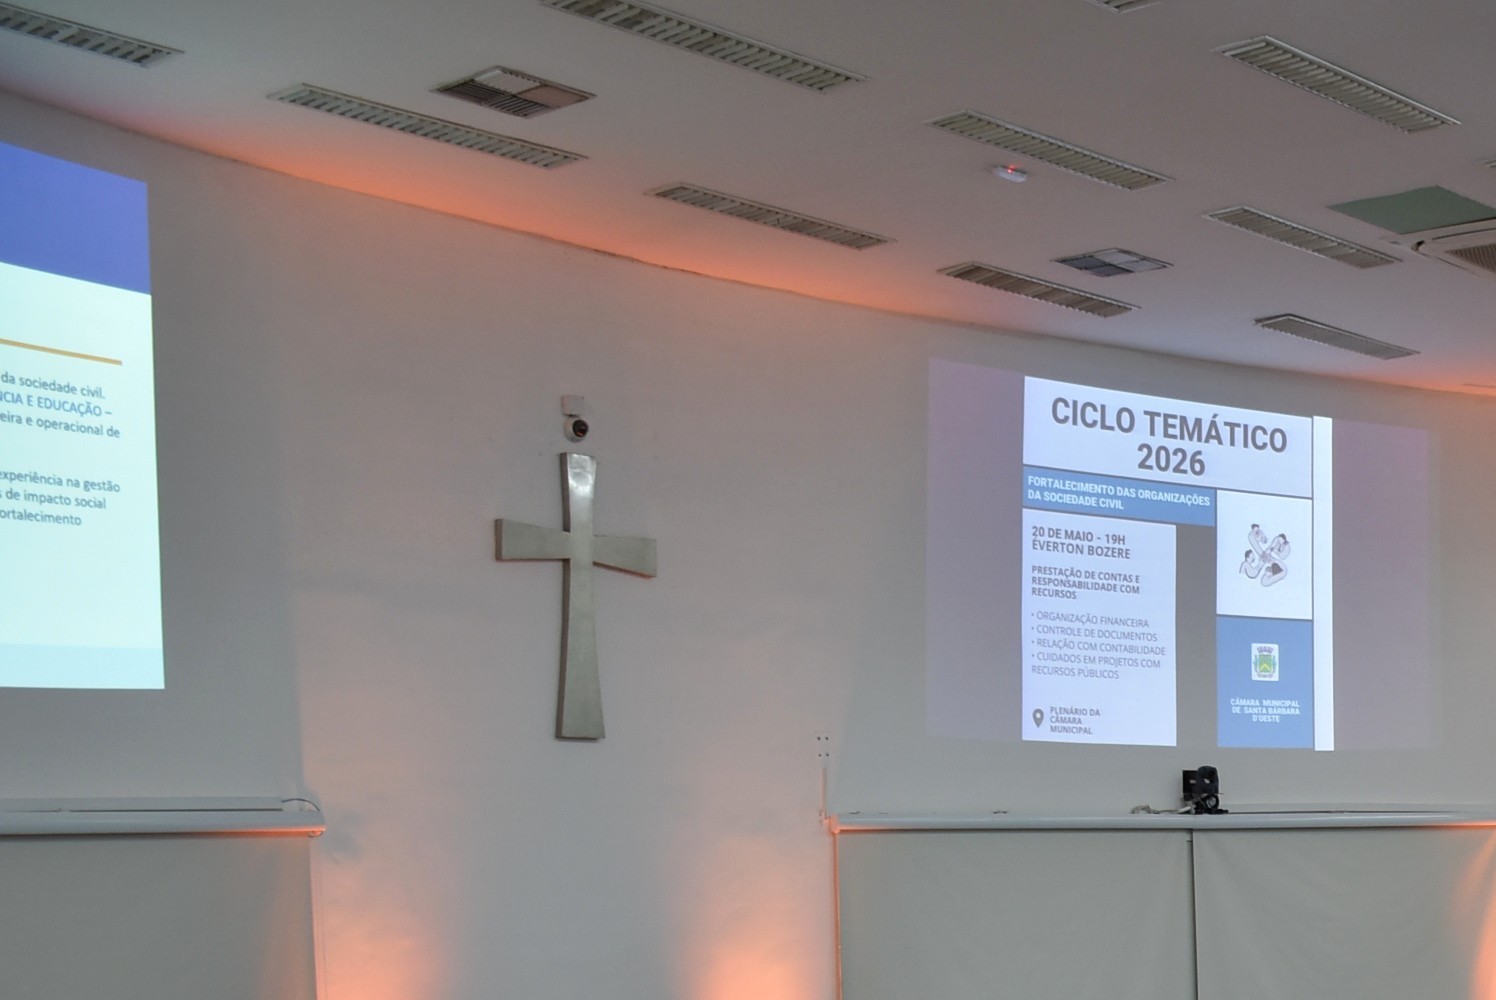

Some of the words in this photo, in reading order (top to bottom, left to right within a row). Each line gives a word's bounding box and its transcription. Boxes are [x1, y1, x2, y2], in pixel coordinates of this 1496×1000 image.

[1, 371, 16, 385] da
[19, 377, 78, 395] sociedade
[80, 385, 106, 399] civil.
[27, 394, 34, 406] E
[37, 396, 102, 417] EDUCAÇÃO
[26, 416, 33, 426] e
[36, 418, 104, 436] operacional
[106, 425, 120, 438] de
[1052, 397, 1135, 434] CICLO
[1143, 411, 1288, 453] TEMÁTICO
[1137, 443, 1206, 476] 2026
[66, 478, 80, 488] na
[83, 479, 120, 492] gestão
[1028, 475, 1115, 496] FORTALECIMENTO
[1117, 486, 1136, 498] DAS
[1138, 489, 1211, 507] ORGANIZAÇÕES
[5, 488, 20, 500] de
[24, 489, 71, 506] impacto
[75, 497, 106, 509] social
[1028, 489, 1041, 500] DA
[1043, 491, 1098, 507] SOCIEDADE
[1099, 498, 1124, 510] CIVIL
[1032, 525, 1045, 538] 20
[1048, 527, 1062, 539] DE
[1064, 529, 1093, 542] MAIO
[1105, 533, 1126, 545] 19H
[1032, 537, 1084, 555] ÉVERTON
[1087, 546, 1131, 559] BOZERE
[1031, 565, 1082, 579] PRESTAÇÃO
[1084, 570, 1096, 580] DE
[1098, 571, 1133, 583] CONTAS
[1135, 575, 1140, 583] E
[1031, 576, 1118, 592] RESPONSABILIDADE
[1120, 584, 1140, 594] COM
[1031, 587, 1077, 600] RECURSOS
[1036, 611, 1098, 625] ORGANIZAÇÃO
[1100, 616, 1149, 628] FINANCEIRA
[1036, 624, 1081, 637] CONTROLE
[1084, 628, 1096, 638] DE
[1097, 629, 1158, 642] DOCUMENTOS
[1037, 638, 1075, 650] RELAÇÃO
[1077, 641, 1097, 651] COM
[1100, 643, 1166, 655] CONTABILIDADE
[1037, 651, 1081, 664] CUIDADOS
[1083, 655, 1096, 664] EM
[1098, 656, 1139, 668] PROJETOS
[1141, 659, 1161, 669] COM
[1031, 665, 1076, 677] RECURSOS
[1077, 667, 1119, 679] PÚBLICOS
[1230, 697, 1260, 706] CÂMARA
[1232, 706, 1241, 714] DE
[1244, 706, 1267, 714] SANTA
[1050, 706, 1088, 716] PLENÁRIO
[1050, 725, 1092, 734] MUNICIPAL
